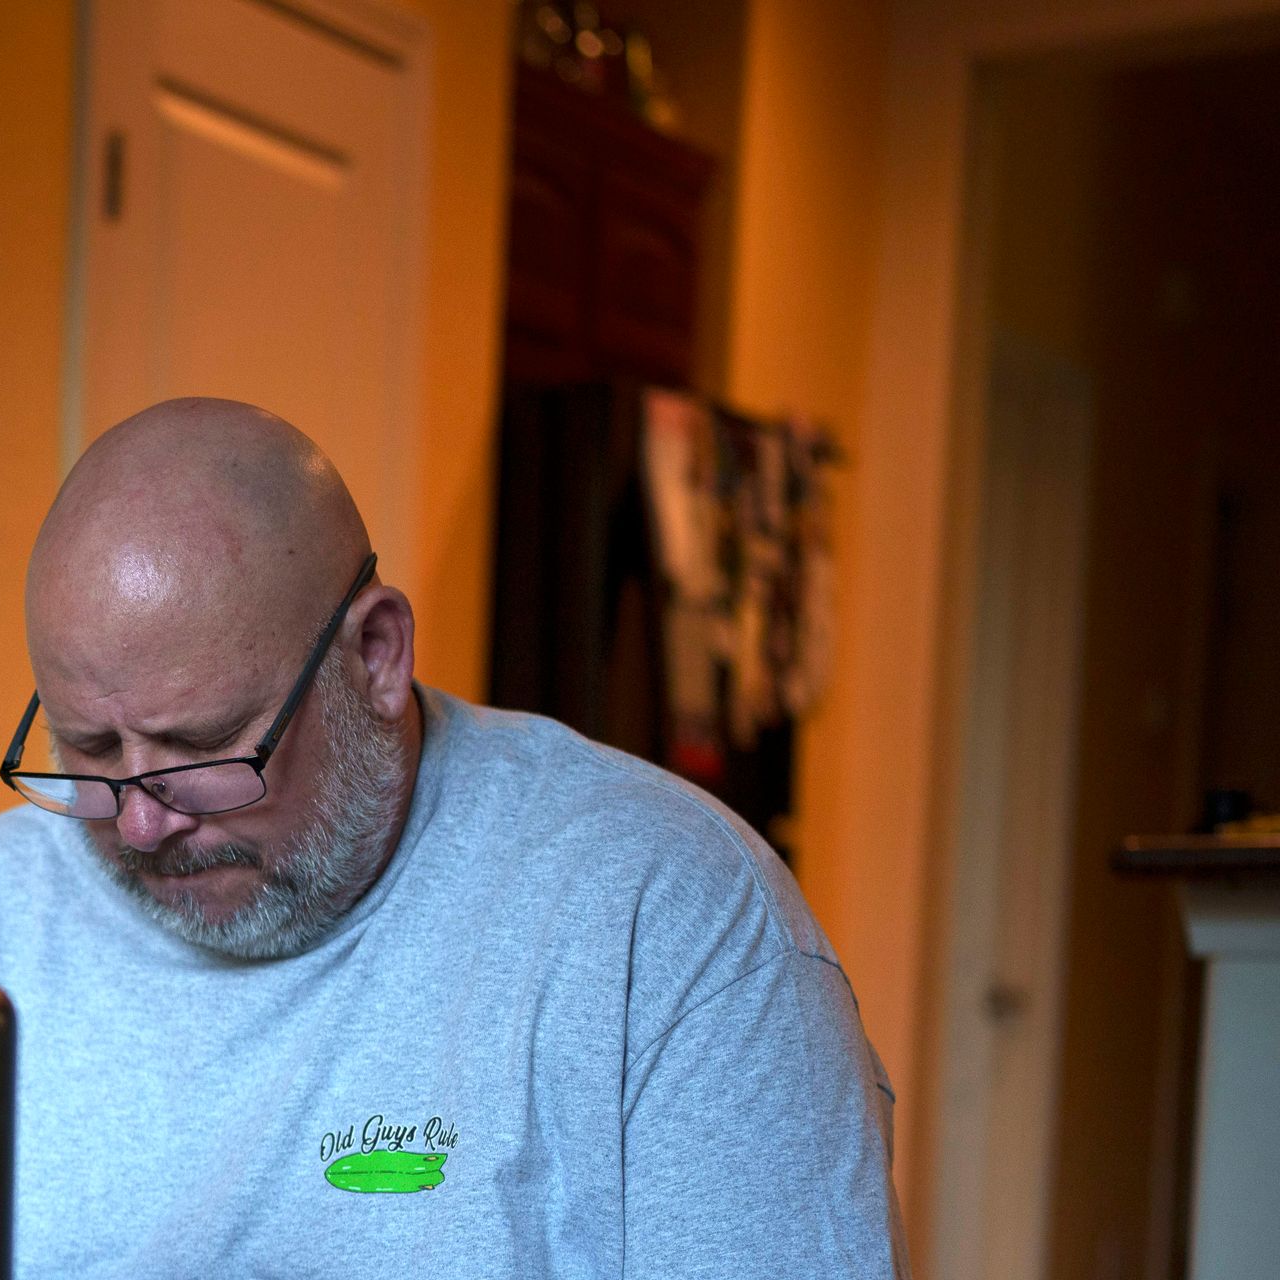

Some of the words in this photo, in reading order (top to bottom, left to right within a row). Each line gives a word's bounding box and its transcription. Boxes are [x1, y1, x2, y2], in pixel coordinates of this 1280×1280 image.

[320, 1125, 354, 1162] Old
[360, 1114, 417, 1155] Guys
[423, 1116, 459, 1151] Rule
